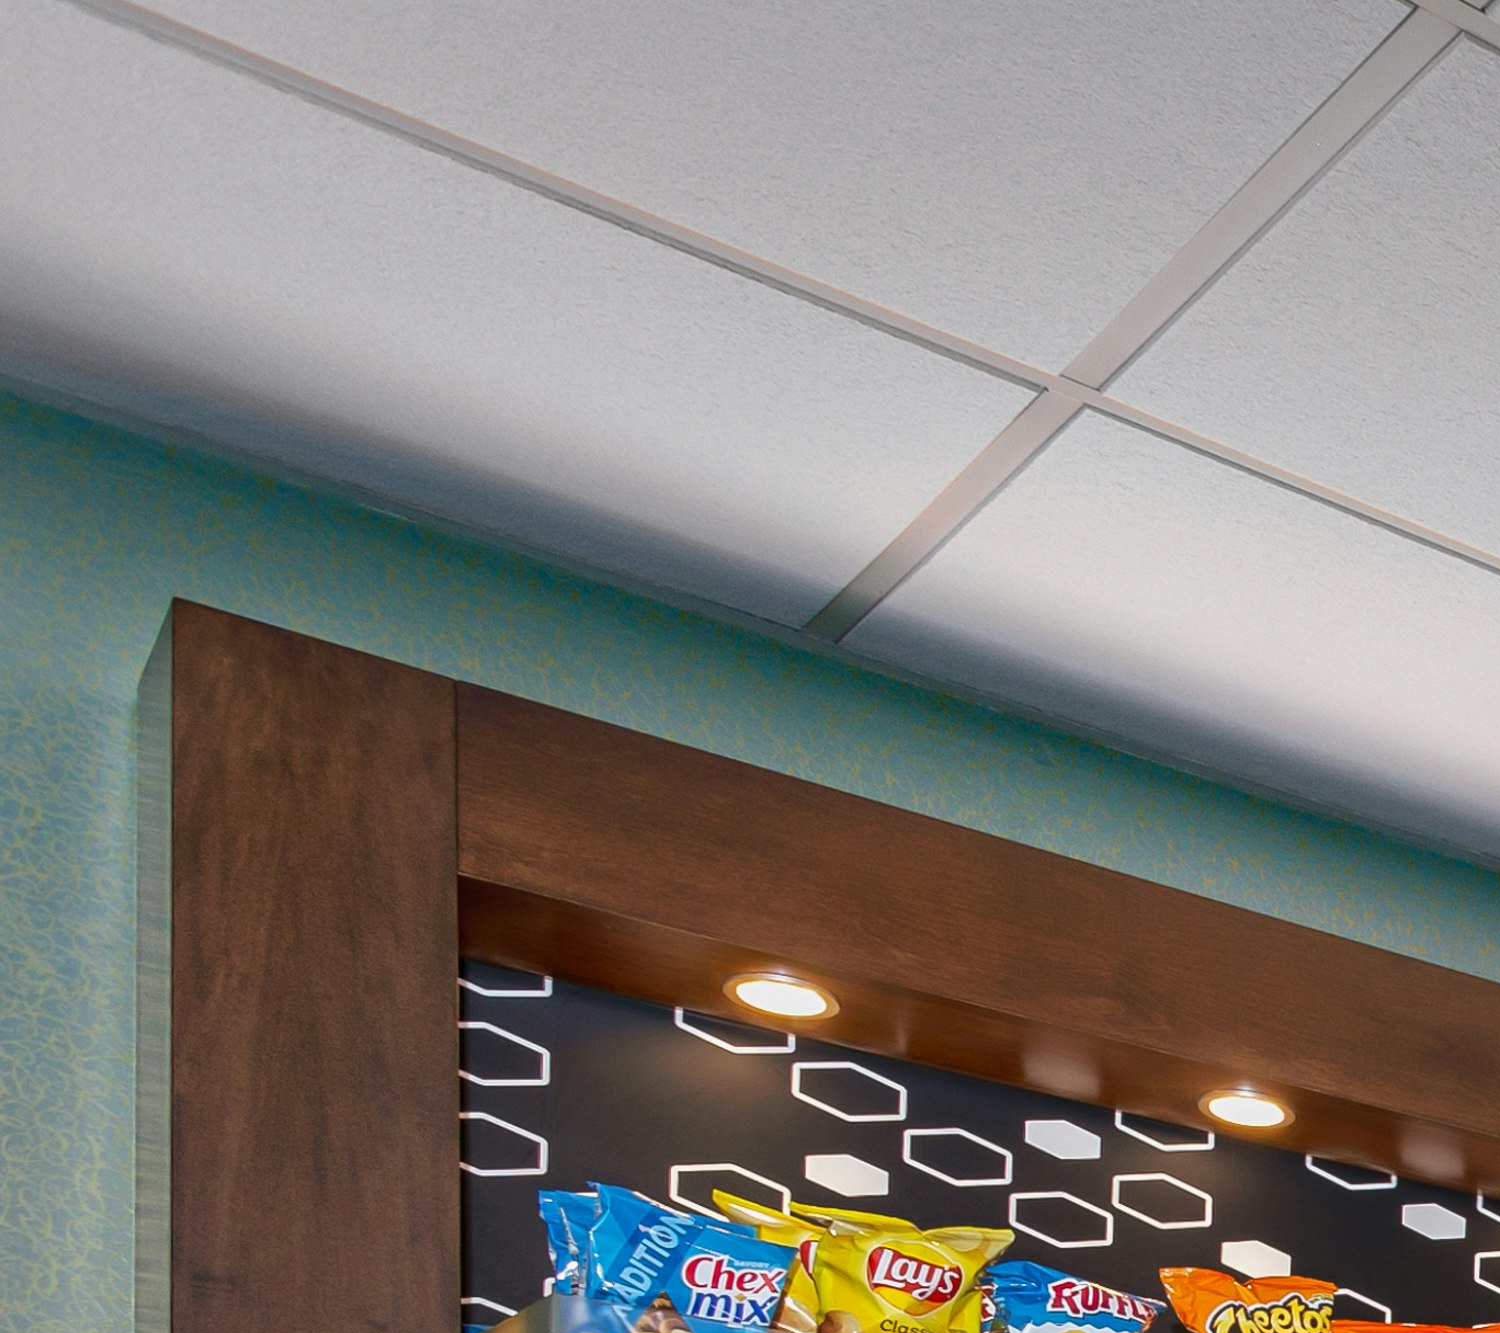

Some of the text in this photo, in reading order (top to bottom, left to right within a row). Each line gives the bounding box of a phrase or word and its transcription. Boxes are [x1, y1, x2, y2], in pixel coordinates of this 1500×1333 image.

[684, 1255, 786, 1293] Chex
[872, 1249, 961, 1301] Lay's
[687, 1290, 777, 1326] mix
[1049, 1280, 1157, 1323] RUFFL
